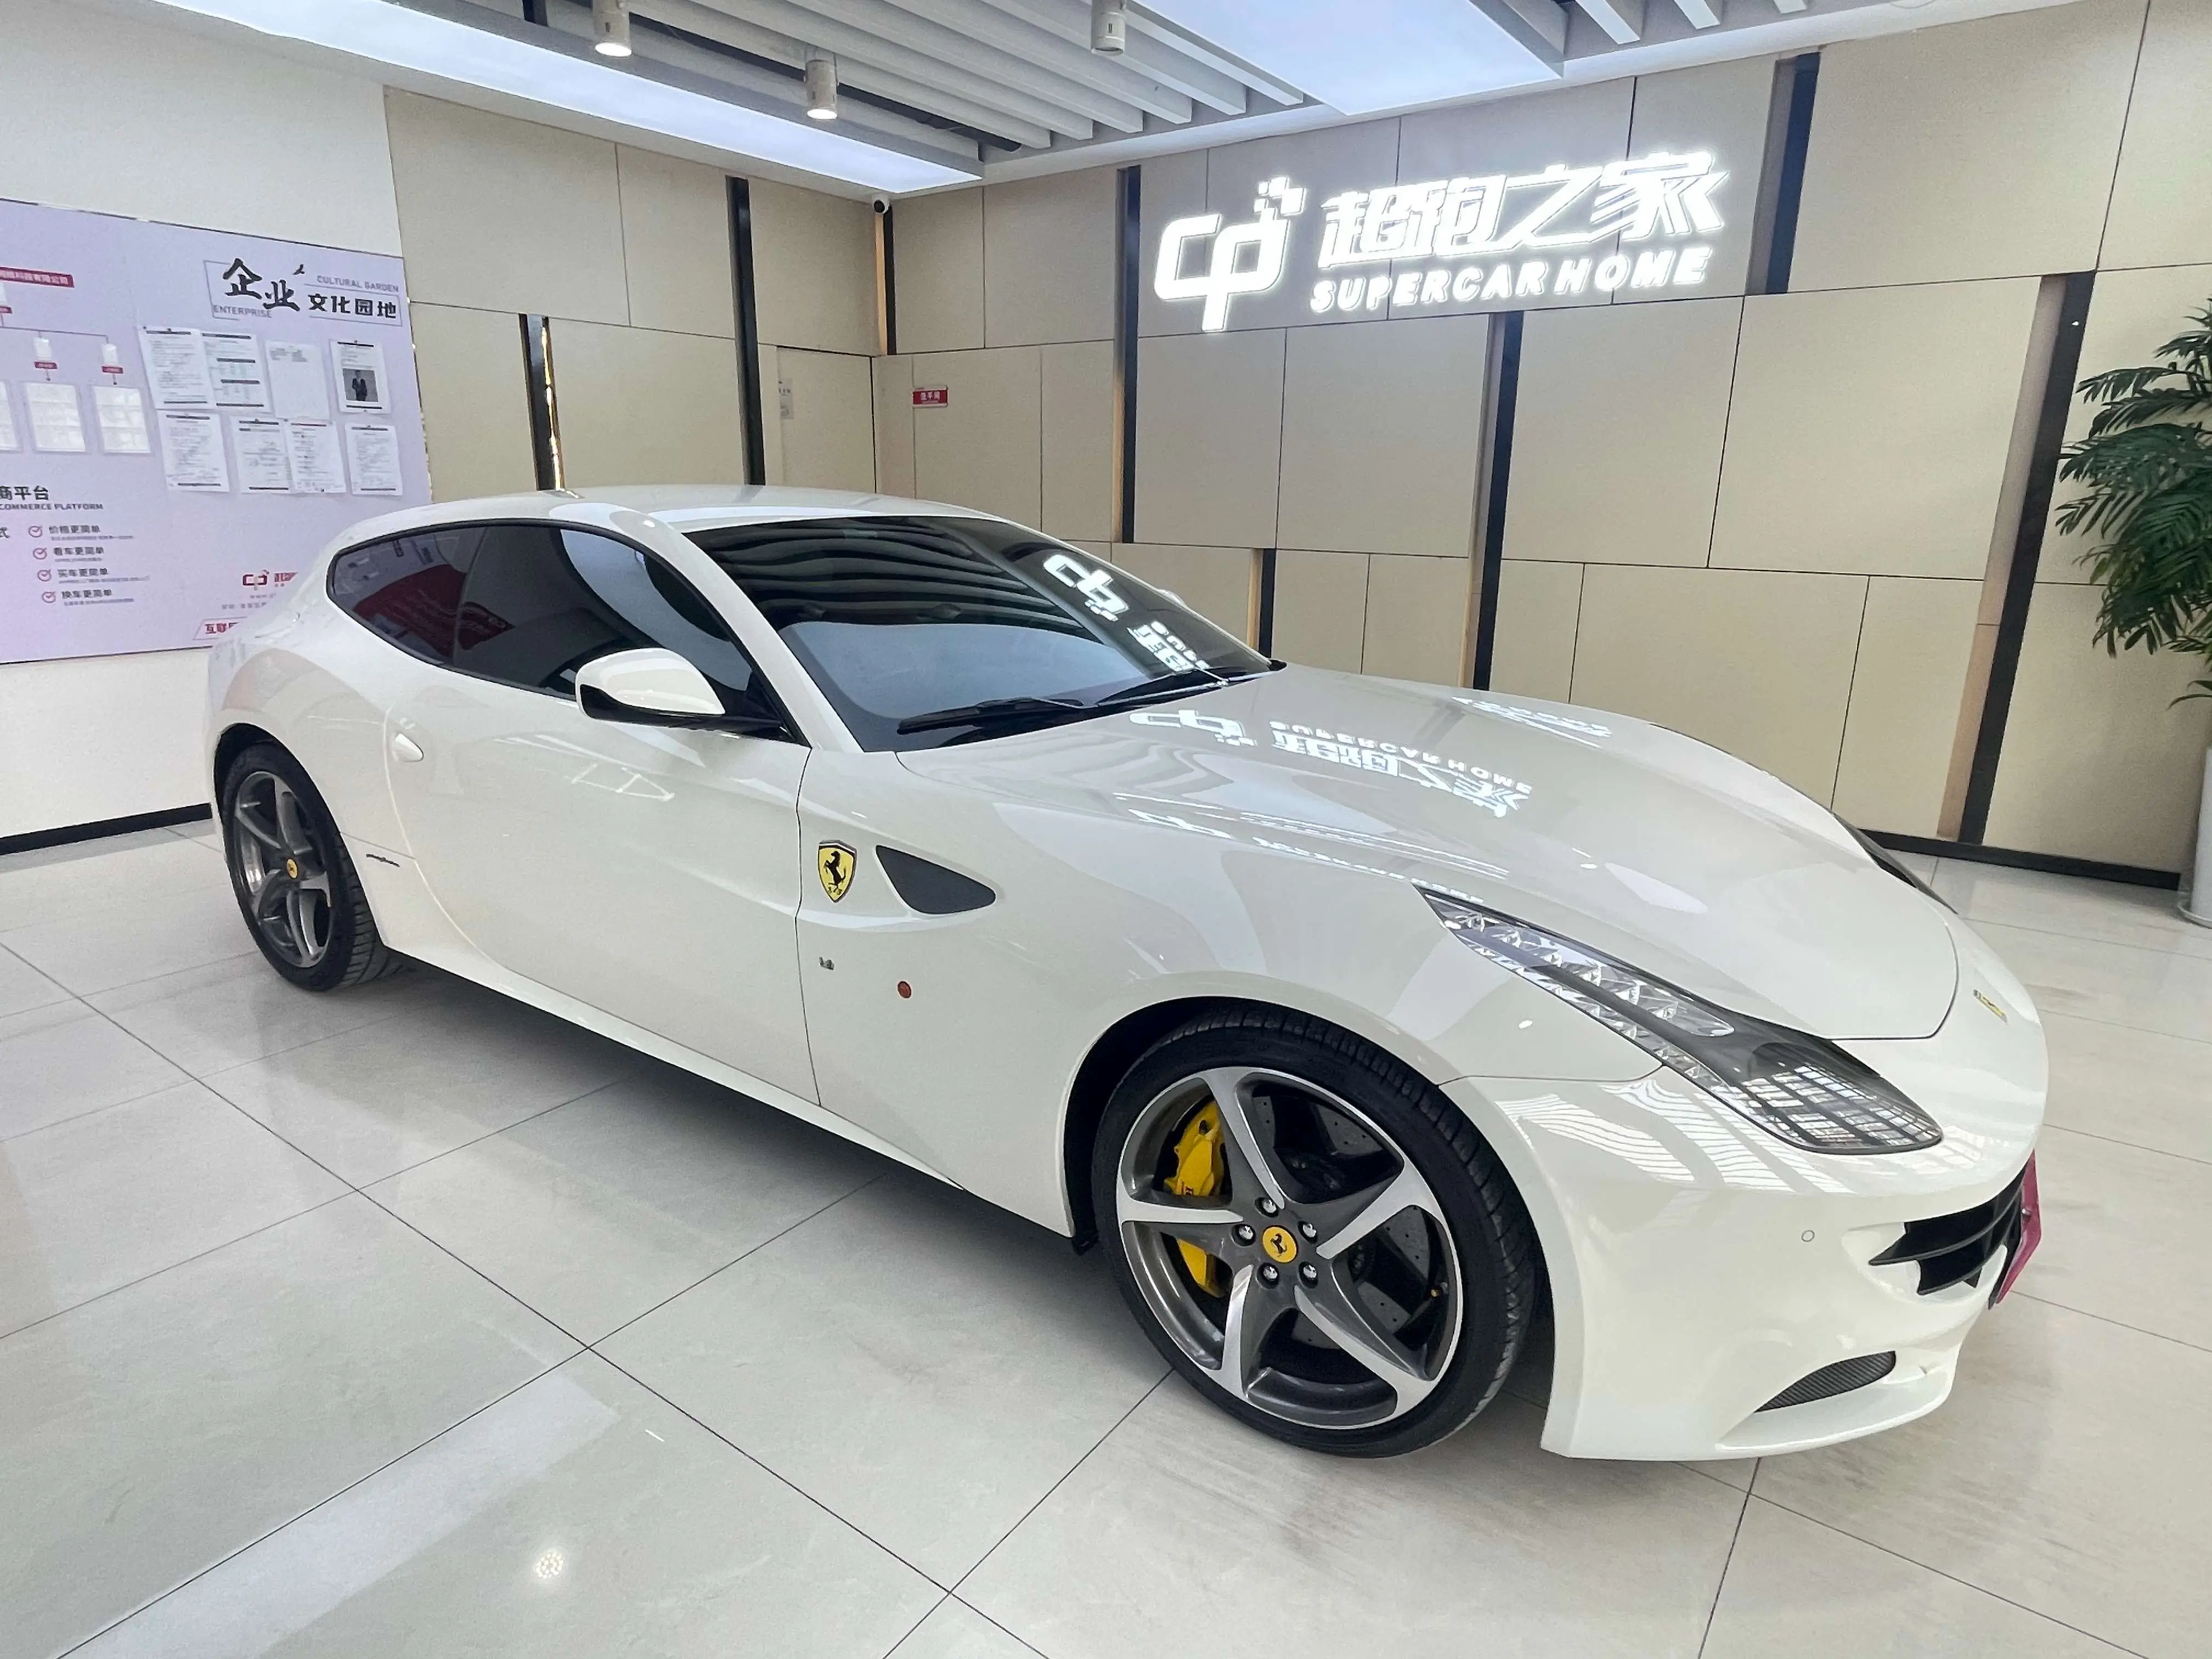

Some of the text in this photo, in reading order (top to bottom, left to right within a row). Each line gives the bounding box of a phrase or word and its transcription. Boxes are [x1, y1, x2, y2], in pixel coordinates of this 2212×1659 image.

[1318, 150, 1730, 269] 超跑之家
[222, 258, 301, 312] 企业
[317, 275, 398, 292] CULTURAL GARDEN
[1310, 246, 1714, 314] SUPERCAR HOME
[213, 305, 272, 318] ENTERPRISE
[308, 293, 396, 318] 文化园地
